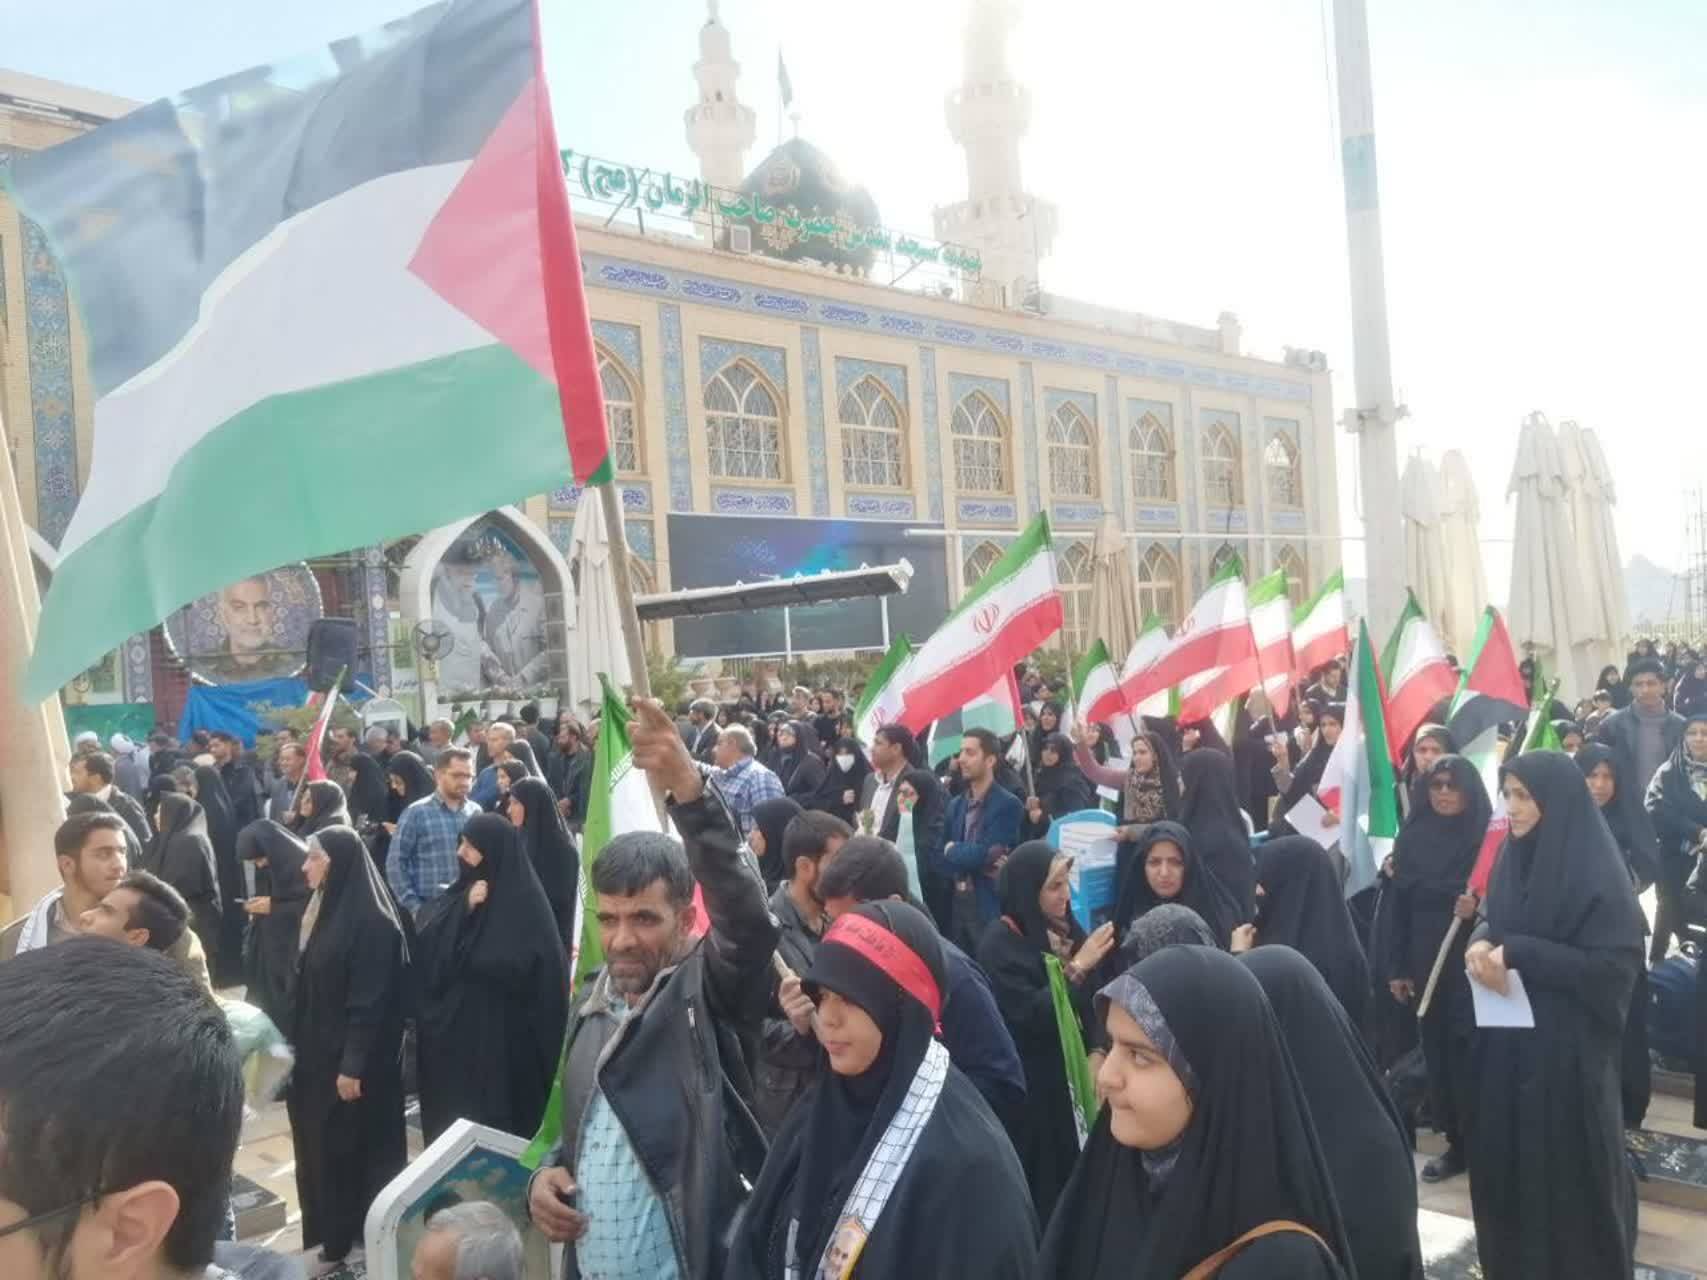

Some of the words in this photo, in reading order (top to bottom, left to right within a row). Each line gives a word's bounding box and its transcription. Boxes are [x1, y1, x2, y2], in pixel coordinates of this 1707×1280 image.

[579, 154, 639, 209] (عج)
[641, 170, 710, 215] الزمان
[717, 191, 776, 224] صاحب
